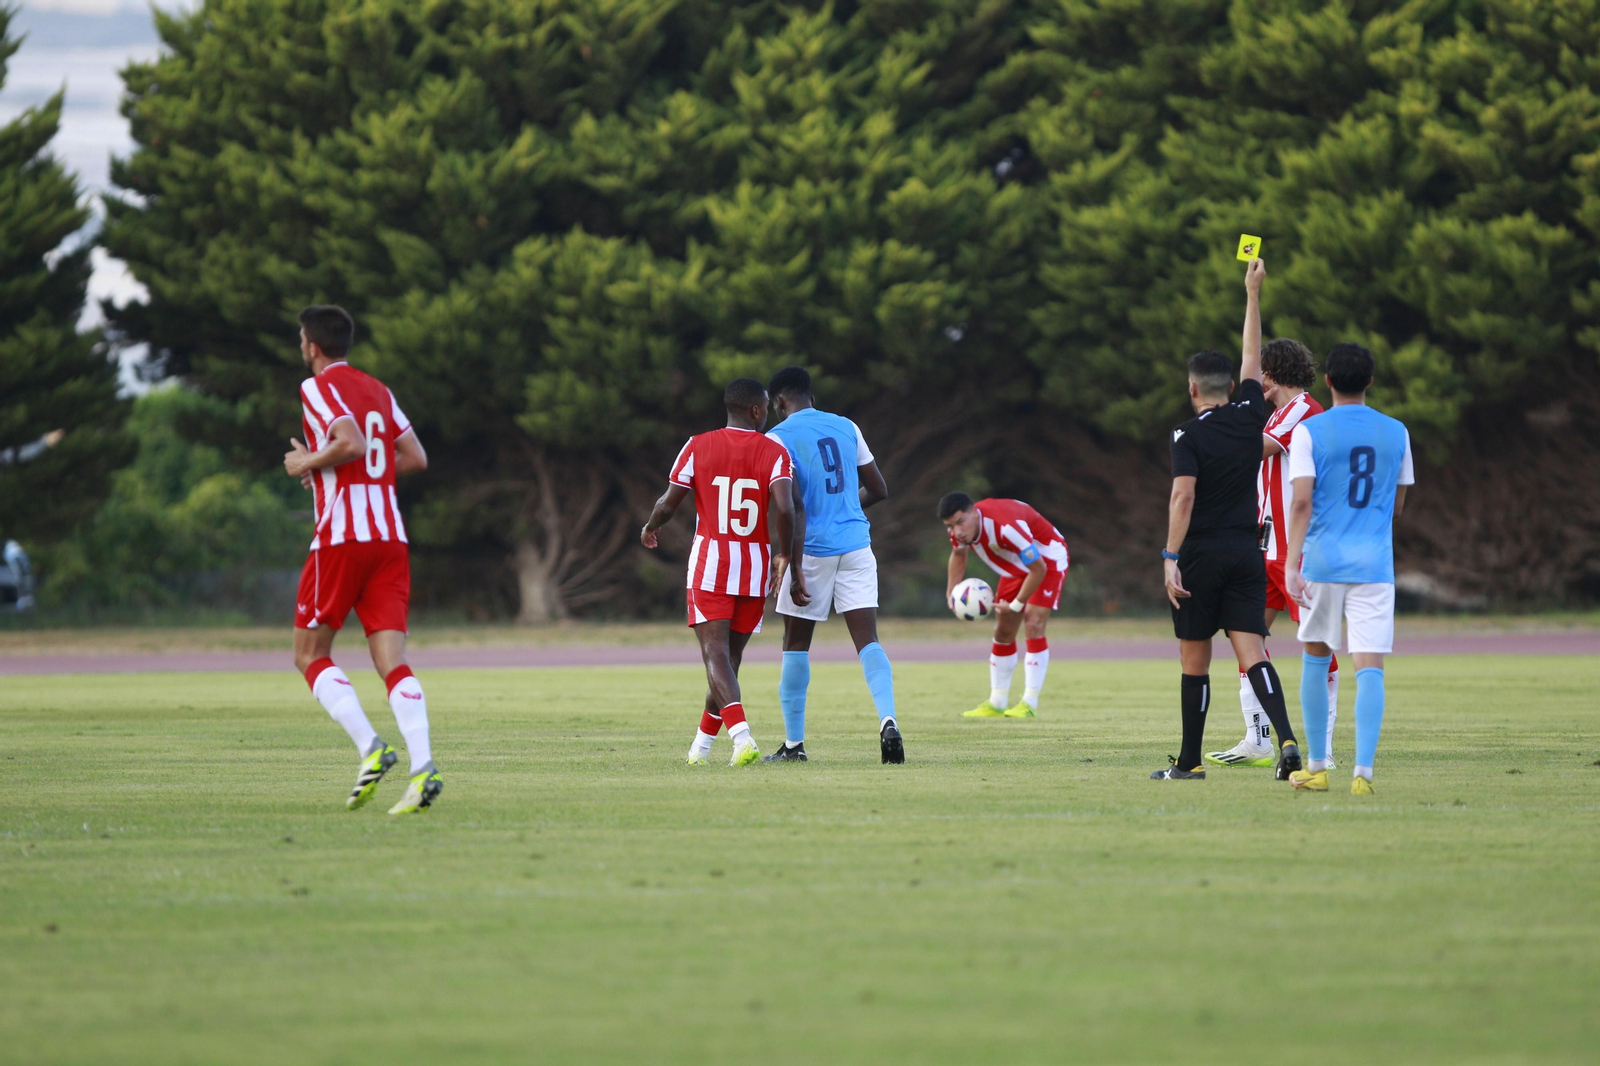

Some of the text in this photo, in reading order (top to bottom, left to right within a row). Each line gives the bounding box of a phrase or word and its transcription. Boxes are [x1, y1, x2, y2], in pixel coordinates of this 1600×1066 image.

[365, 410, 386, 479] 6
[816, 436, 845, 495] 9
[711, 475, 760, 537] 15
[1348, 445, 1376, 509] 8
